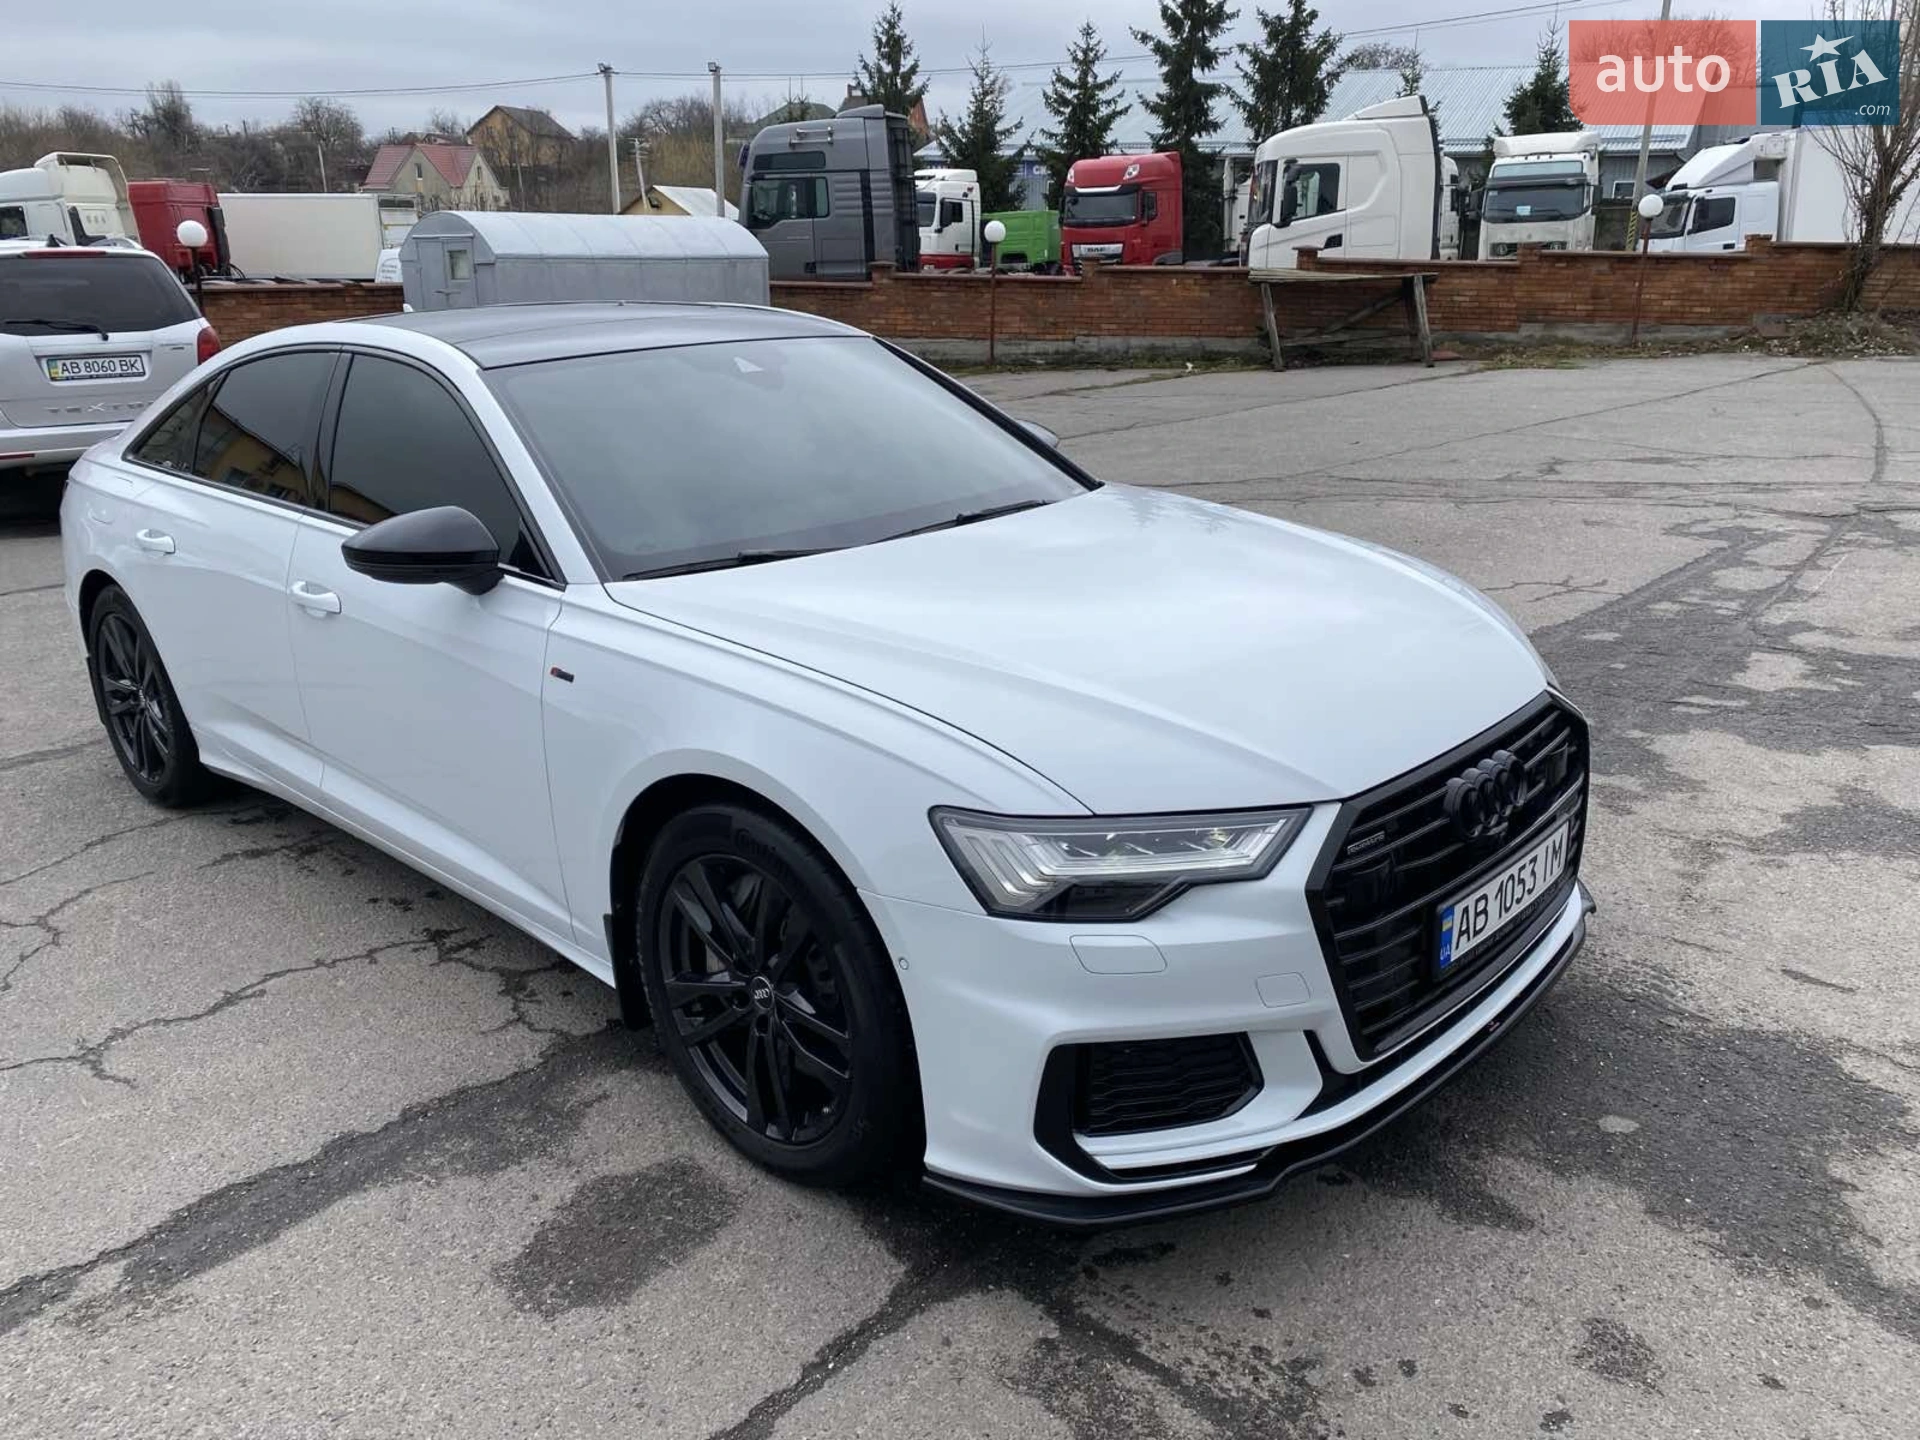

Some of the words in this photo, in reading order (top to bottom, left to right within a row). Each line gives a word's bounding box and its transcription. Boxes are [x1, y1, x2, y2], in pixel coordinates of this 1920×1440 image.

[61, 361, 81, 375] AB
[84, 360, 116, 374] 8060
[119, 359, 140, 372] BK
[1455, 892, 1489, 951] AB
[1494, 853, 1538, 920] 1053
[1543, 832, 1564, 883] IM
